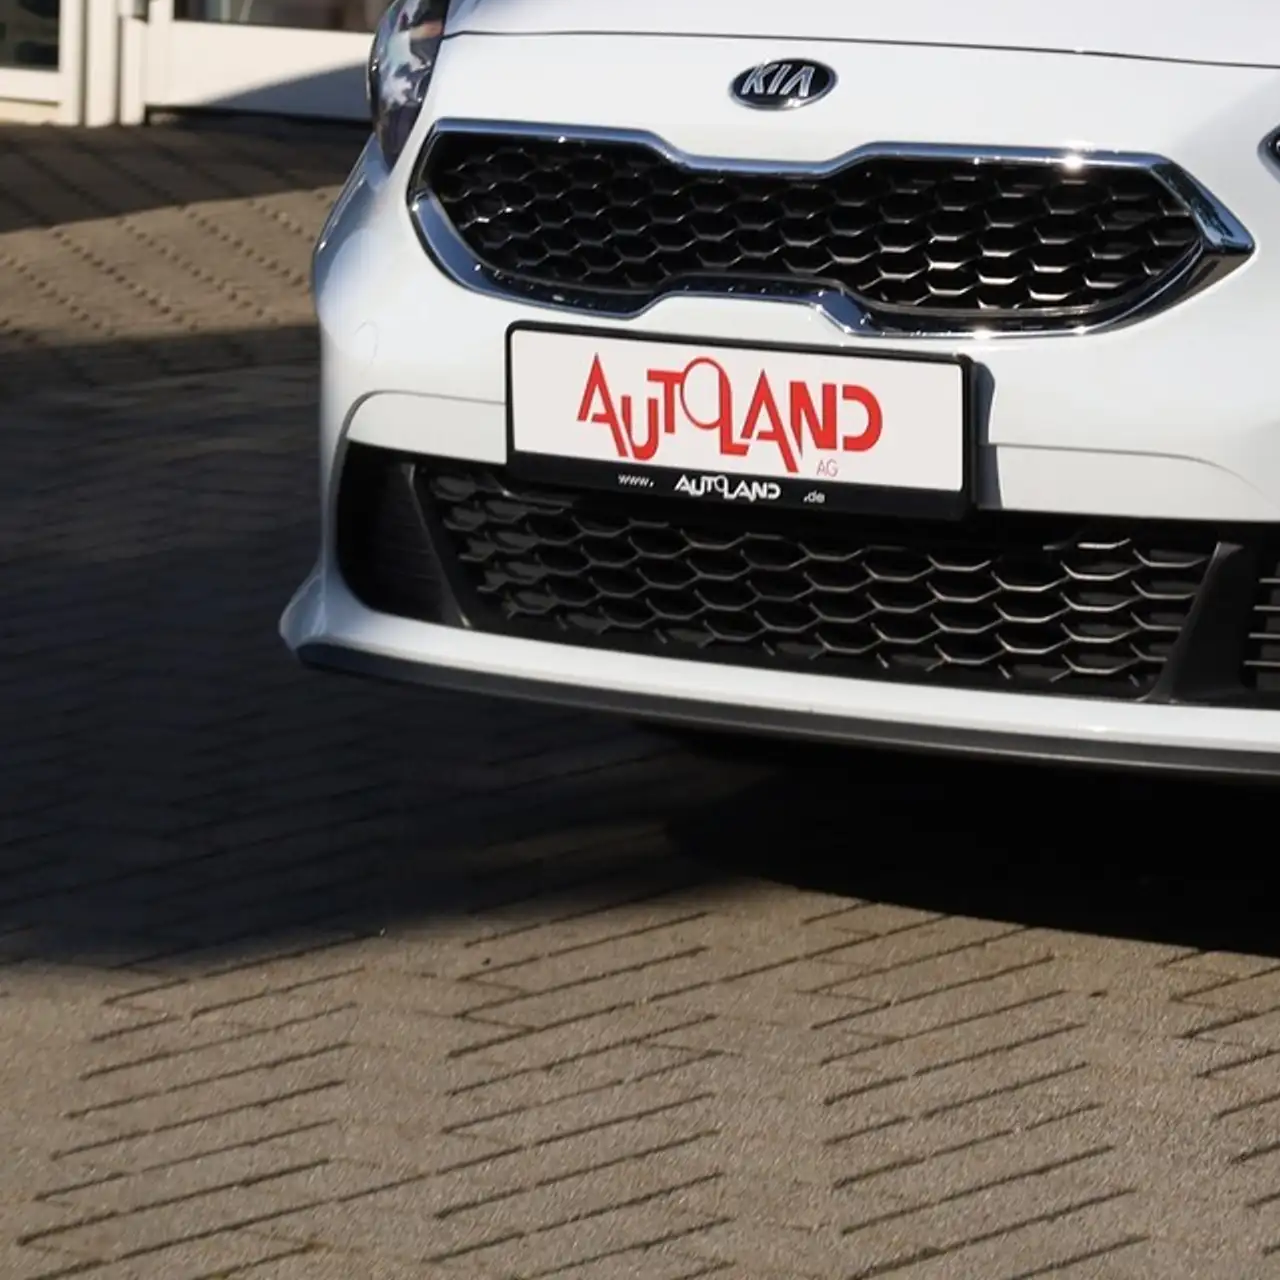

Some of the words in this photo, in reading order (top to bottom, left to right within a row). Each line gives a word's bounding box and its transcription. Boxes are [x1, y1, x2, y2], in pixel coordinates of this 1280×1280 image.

[741, 63, 816, 97] KIA
[577, 351, 883, 473] AUTOLAND
[816, 459, 838, 477] AG
[618, 474, 654, 487] www.
[674, 474, 781, 502] AUTOLAND
